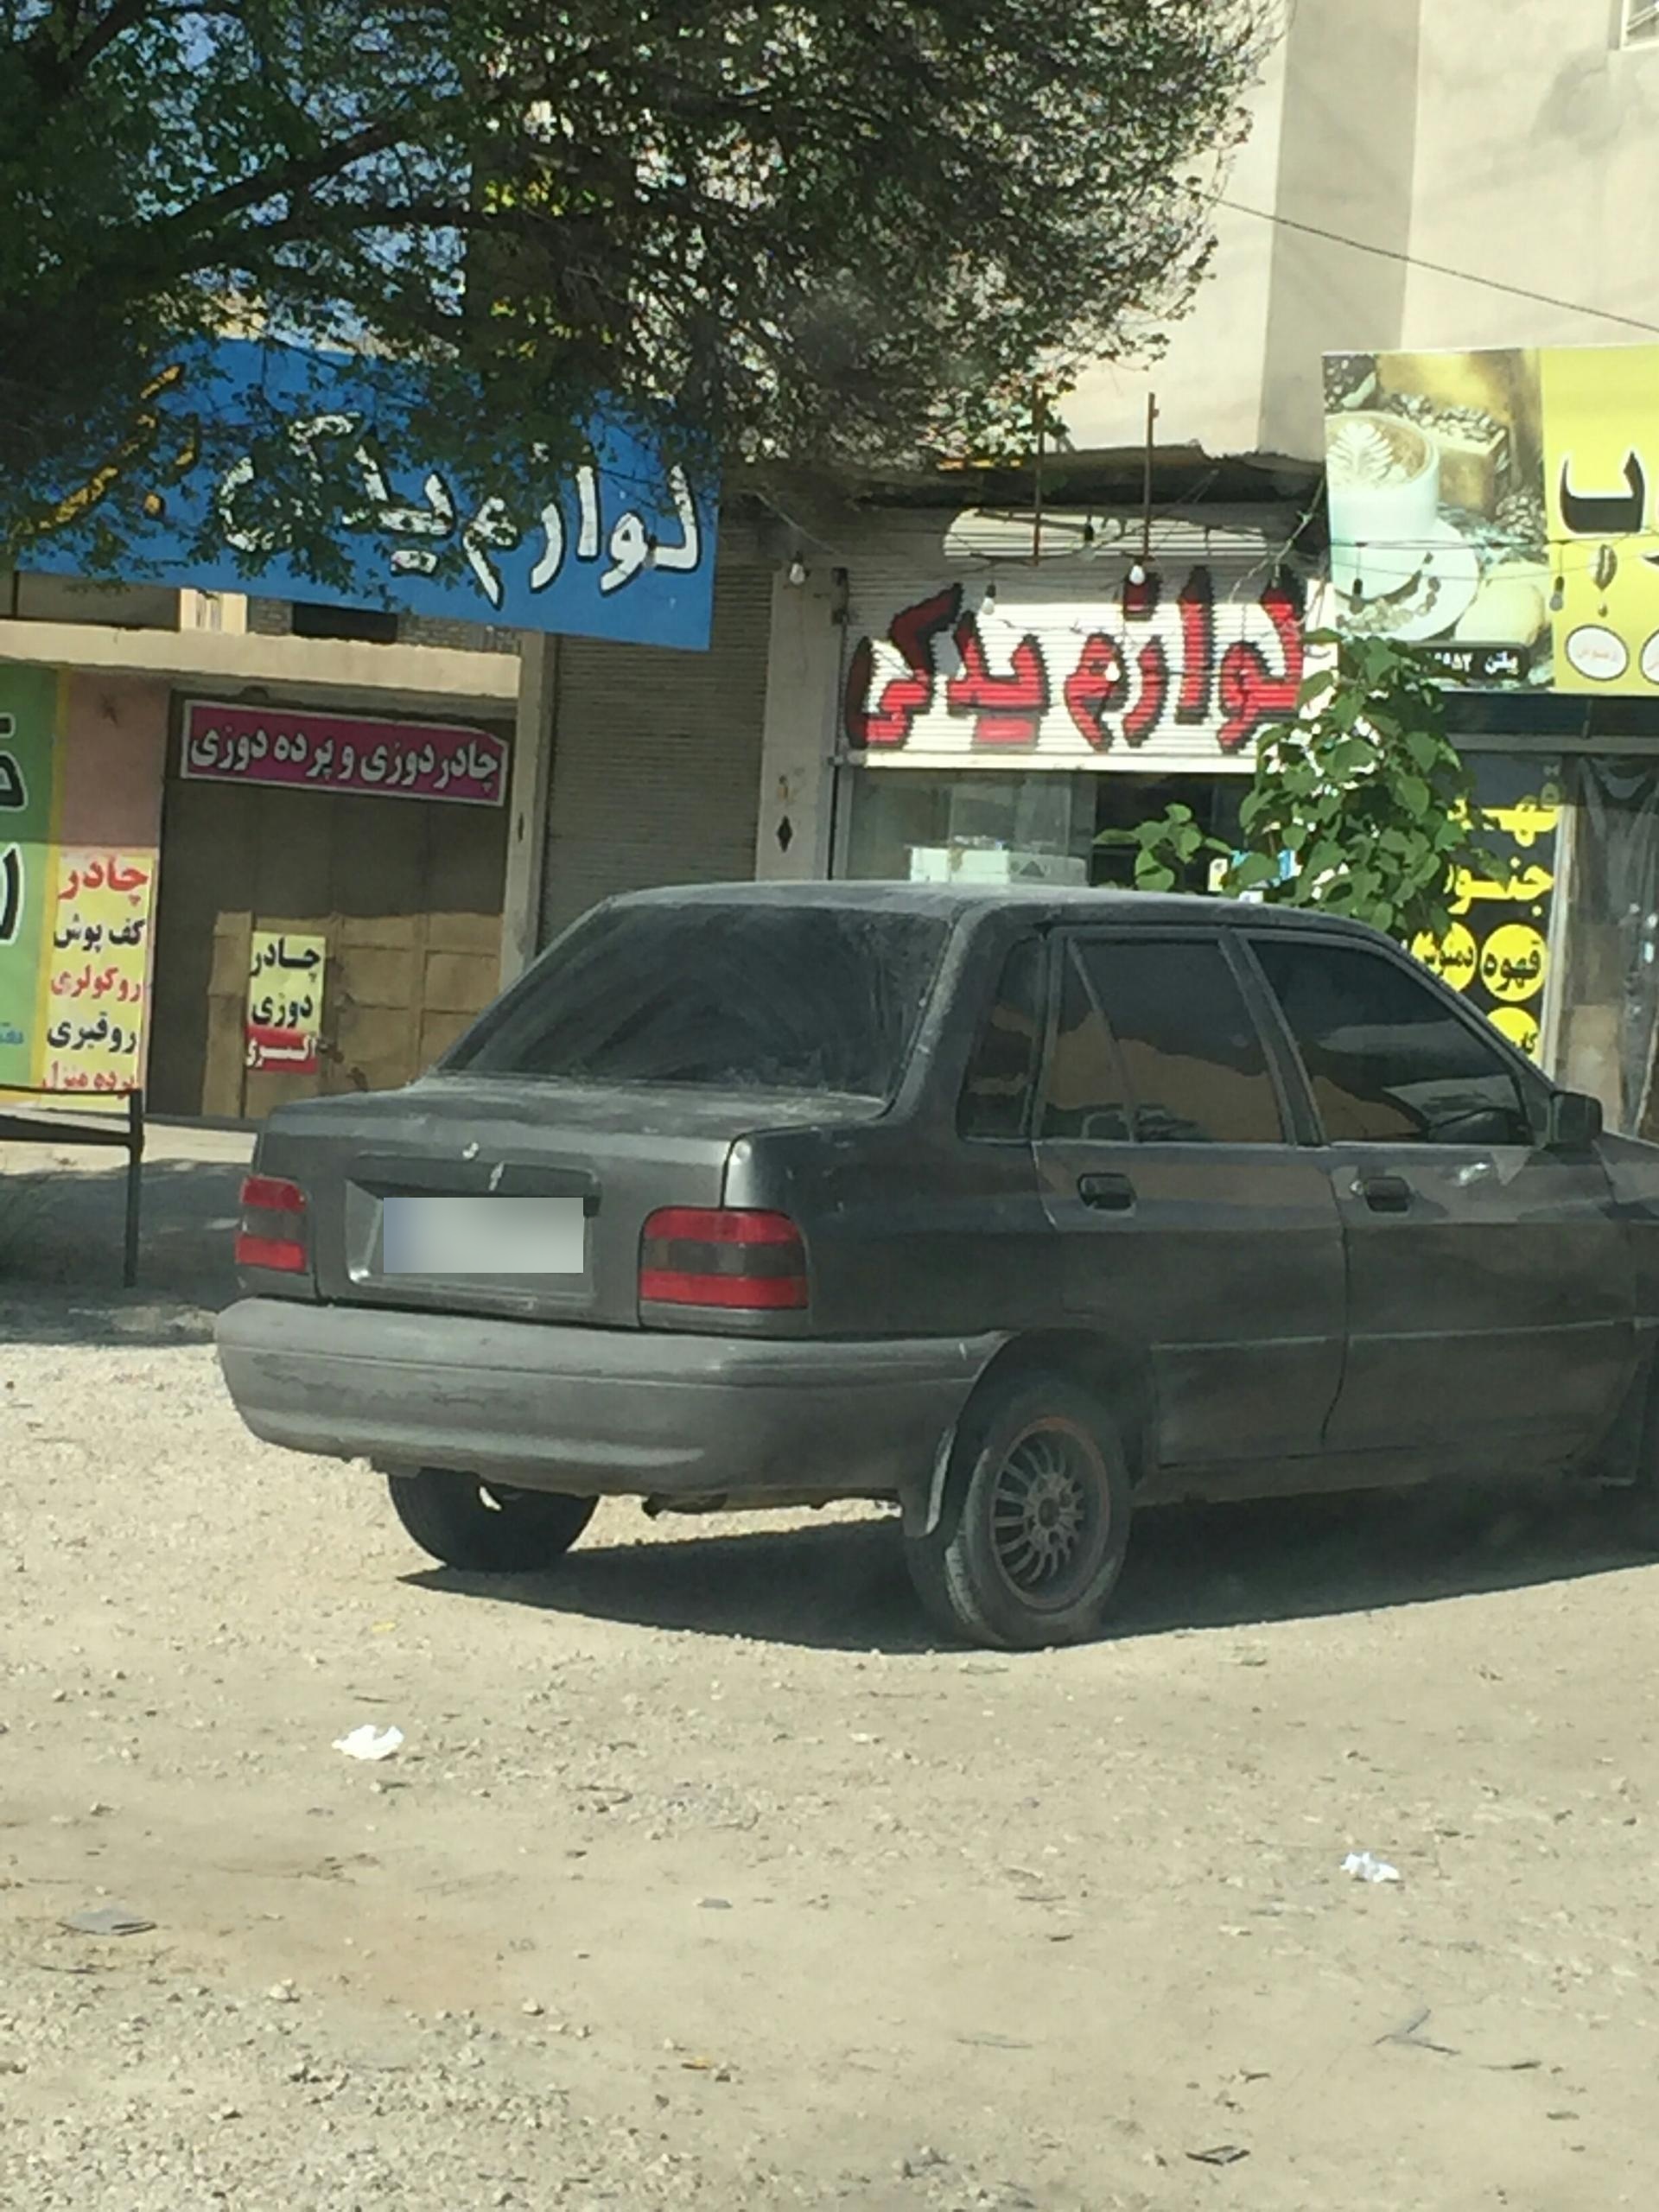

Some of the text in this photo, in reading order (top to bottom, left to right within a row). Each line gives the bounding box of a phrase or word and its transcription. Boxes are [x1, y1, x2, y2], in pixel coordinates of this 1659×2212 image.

[461, 441, 702, 610] لوازم
[845, 564, 1308, 755] لوازم یدکی
[190, 725, 269, 772] دوزی
[338, 744, 355, 780] و
[57, 855, 149, 907] چادر
[249, 936, 321, 983] چادر
[1483, 939, 1541, 992] قهوه
[251, 992, 314, 1028] دوزی
